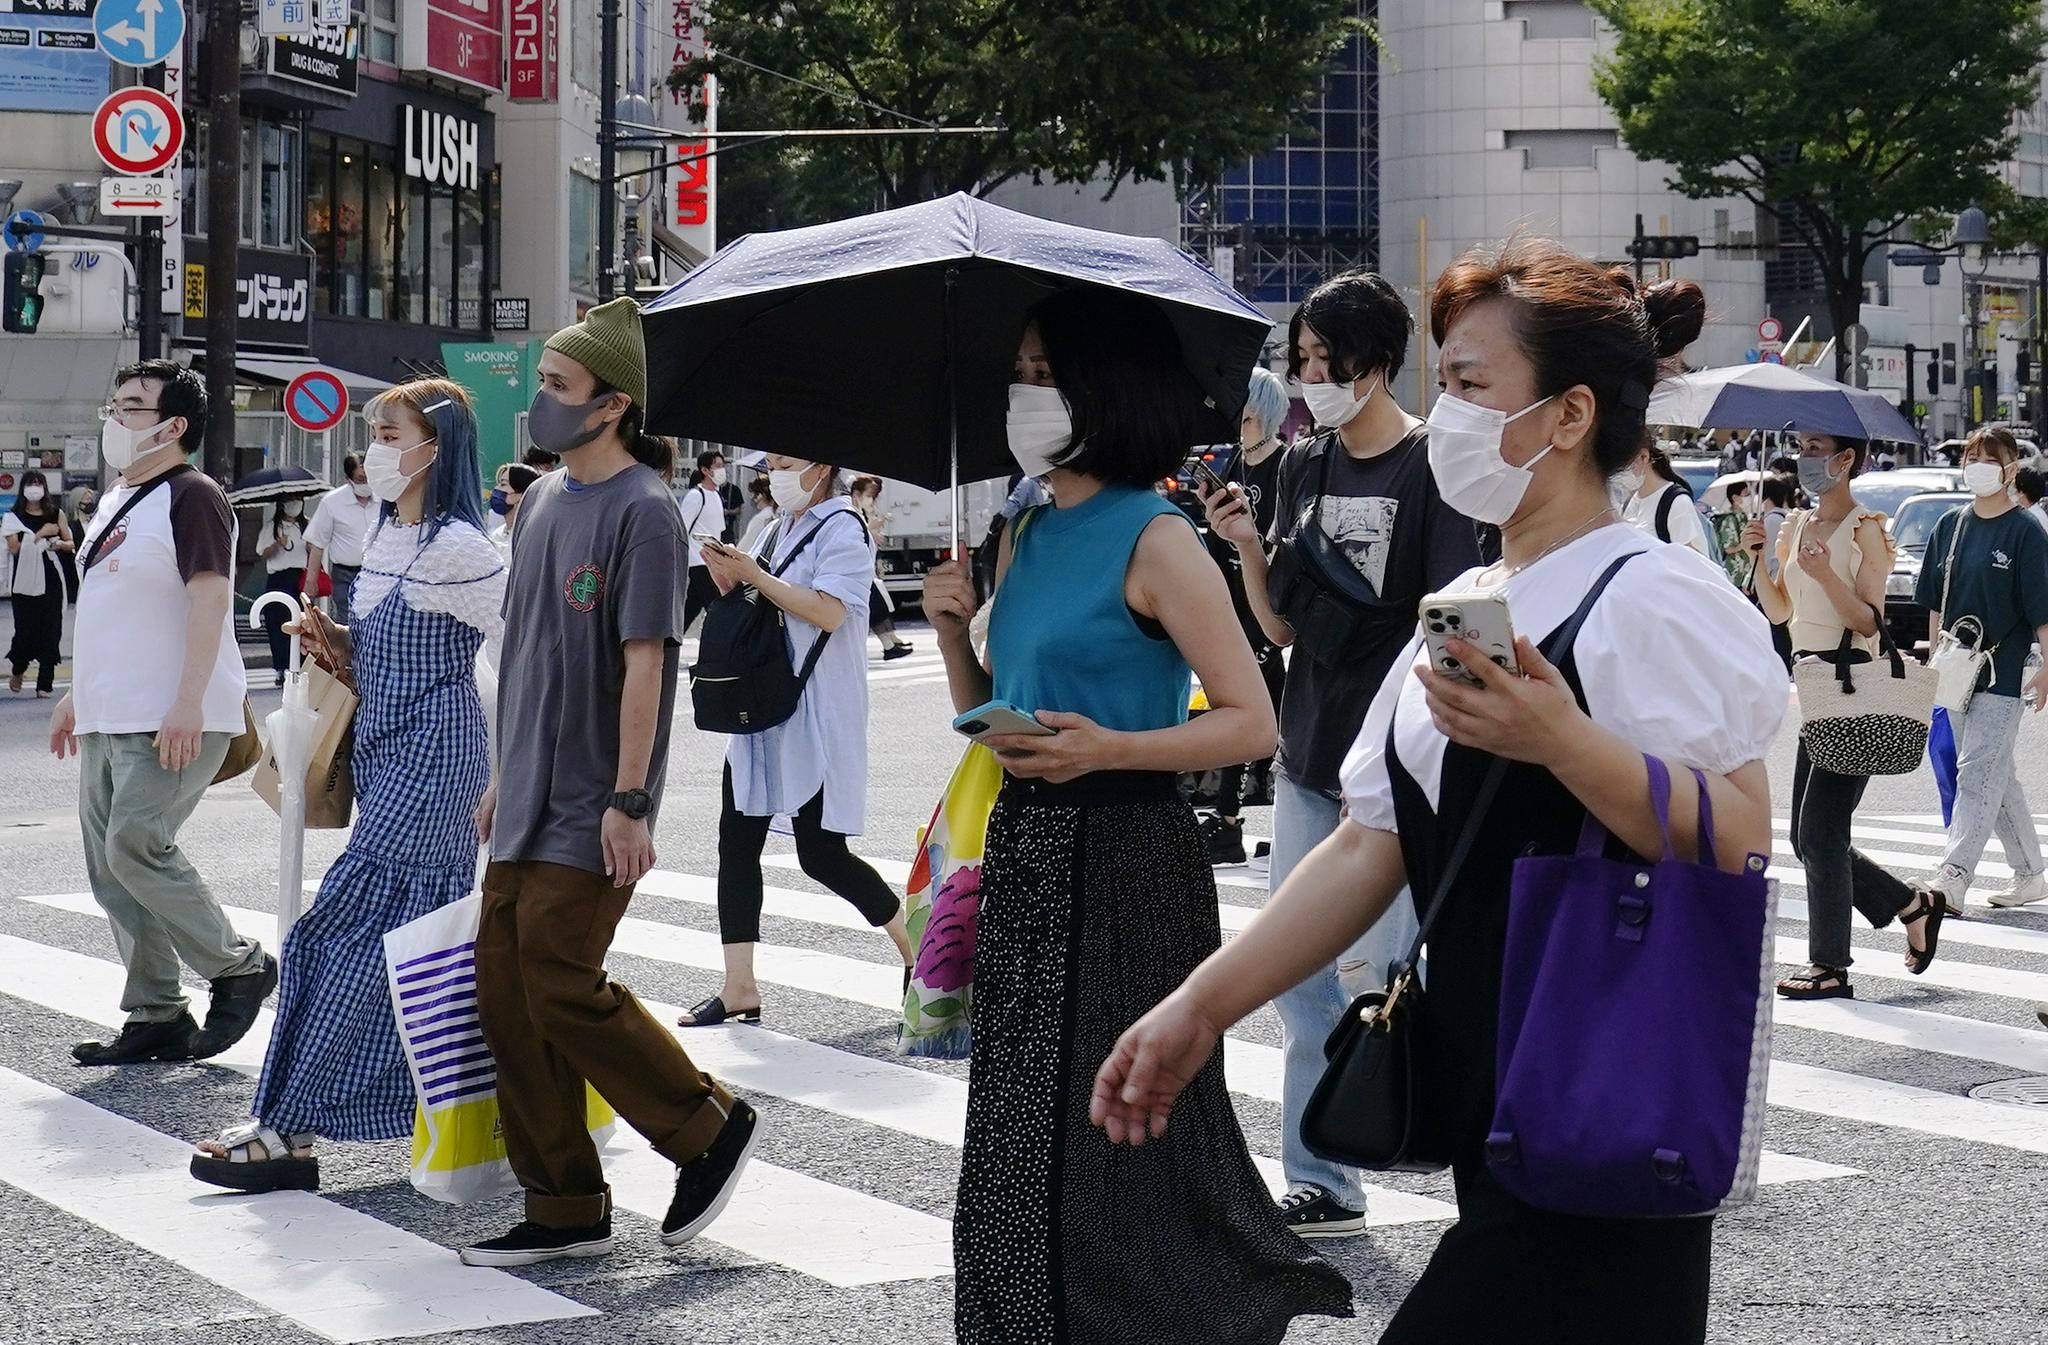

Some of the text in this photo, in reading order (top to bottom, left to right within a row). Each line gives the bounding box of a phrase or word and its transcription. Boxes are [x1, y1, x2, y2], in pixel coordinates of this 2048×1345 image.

[458, 32, 472, 68] 3F
[291, 52, 307, 70] DRUG
[312, 58, 339, 79] COSMETIC
[517, 70, 535, 82] 3F
[405, 104, 478, 190] LUSH
[113, 184, 121, 195] 8
[145, 183, 162, 195] 20
[496, 300, 526, 310] LUSH
[496, 310, 526, 318] FRESH
[464, 351, 519, 363] SMOKING
